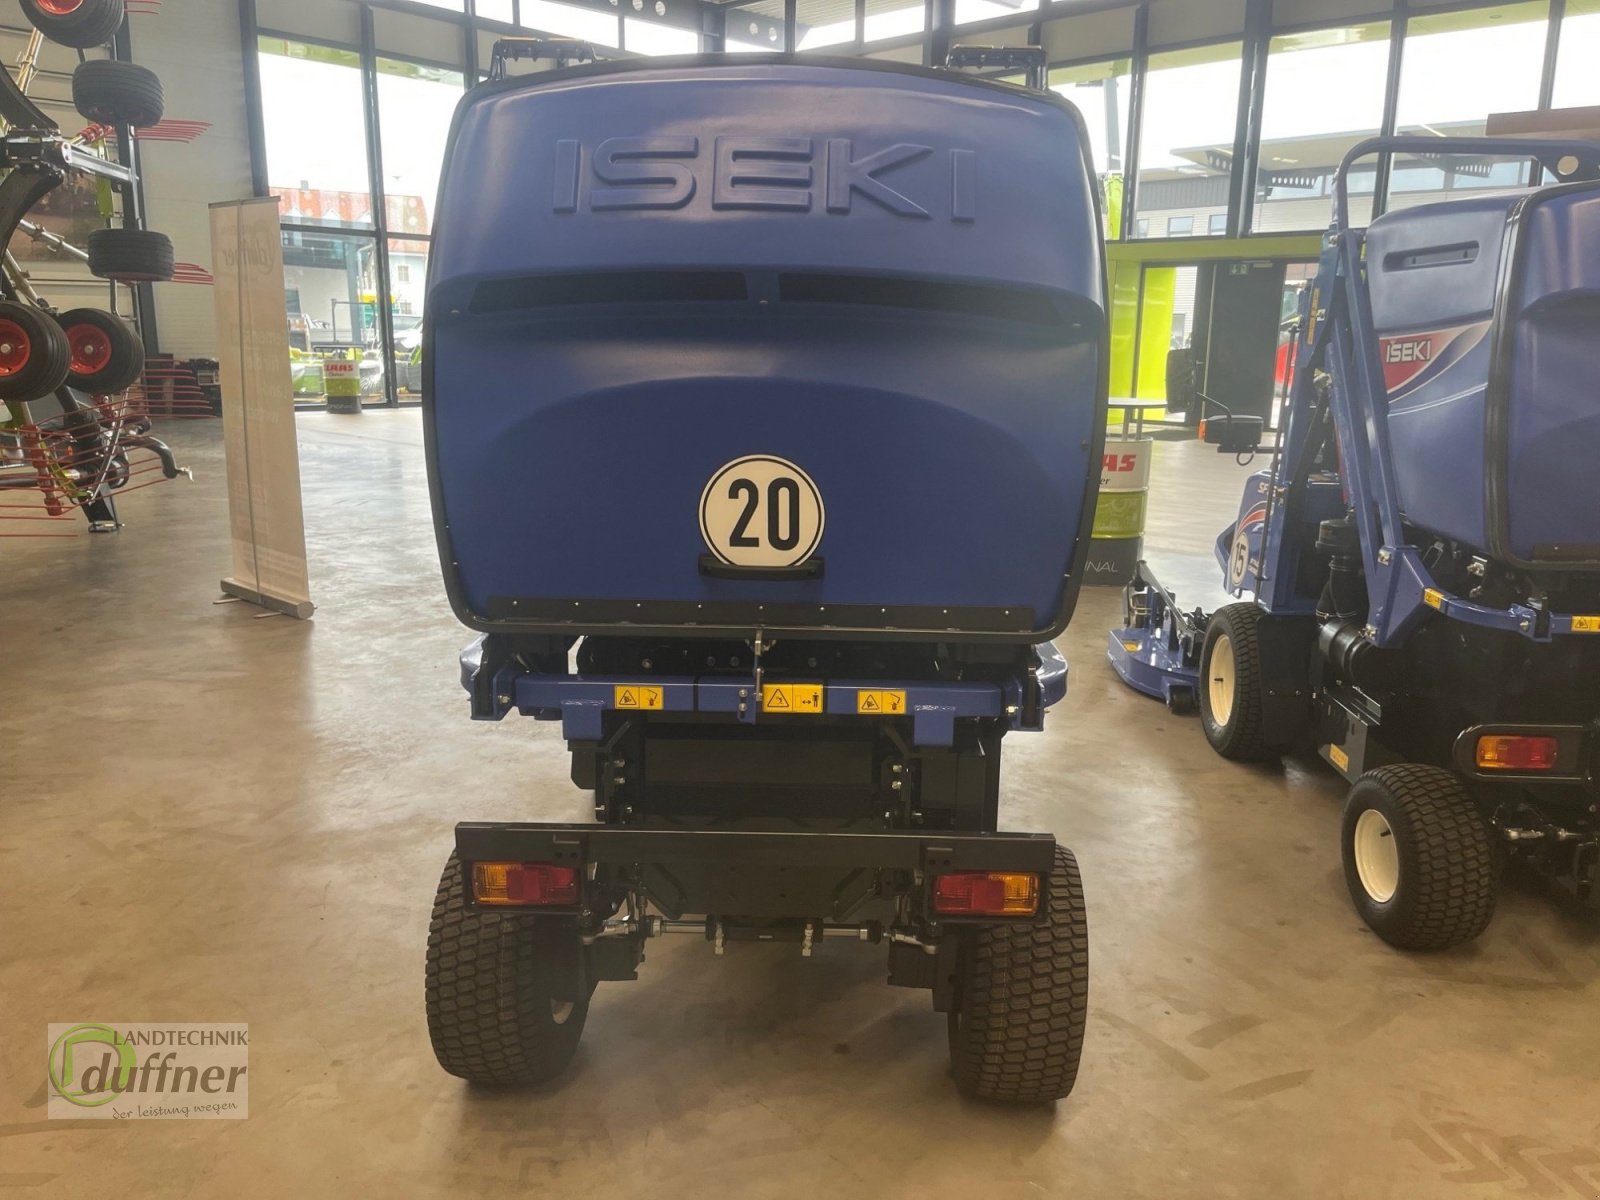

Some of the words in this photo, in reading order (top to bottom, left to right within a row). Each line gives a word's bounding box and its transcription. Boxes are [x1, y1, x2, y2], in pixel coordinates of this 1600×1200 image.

[552, 135, 976, 224] ISEKI
[1386, 340, 1431, 363] ISEKI
[728, 477, 800, 551] 20
[1233, 542, 1247, 578] 15
